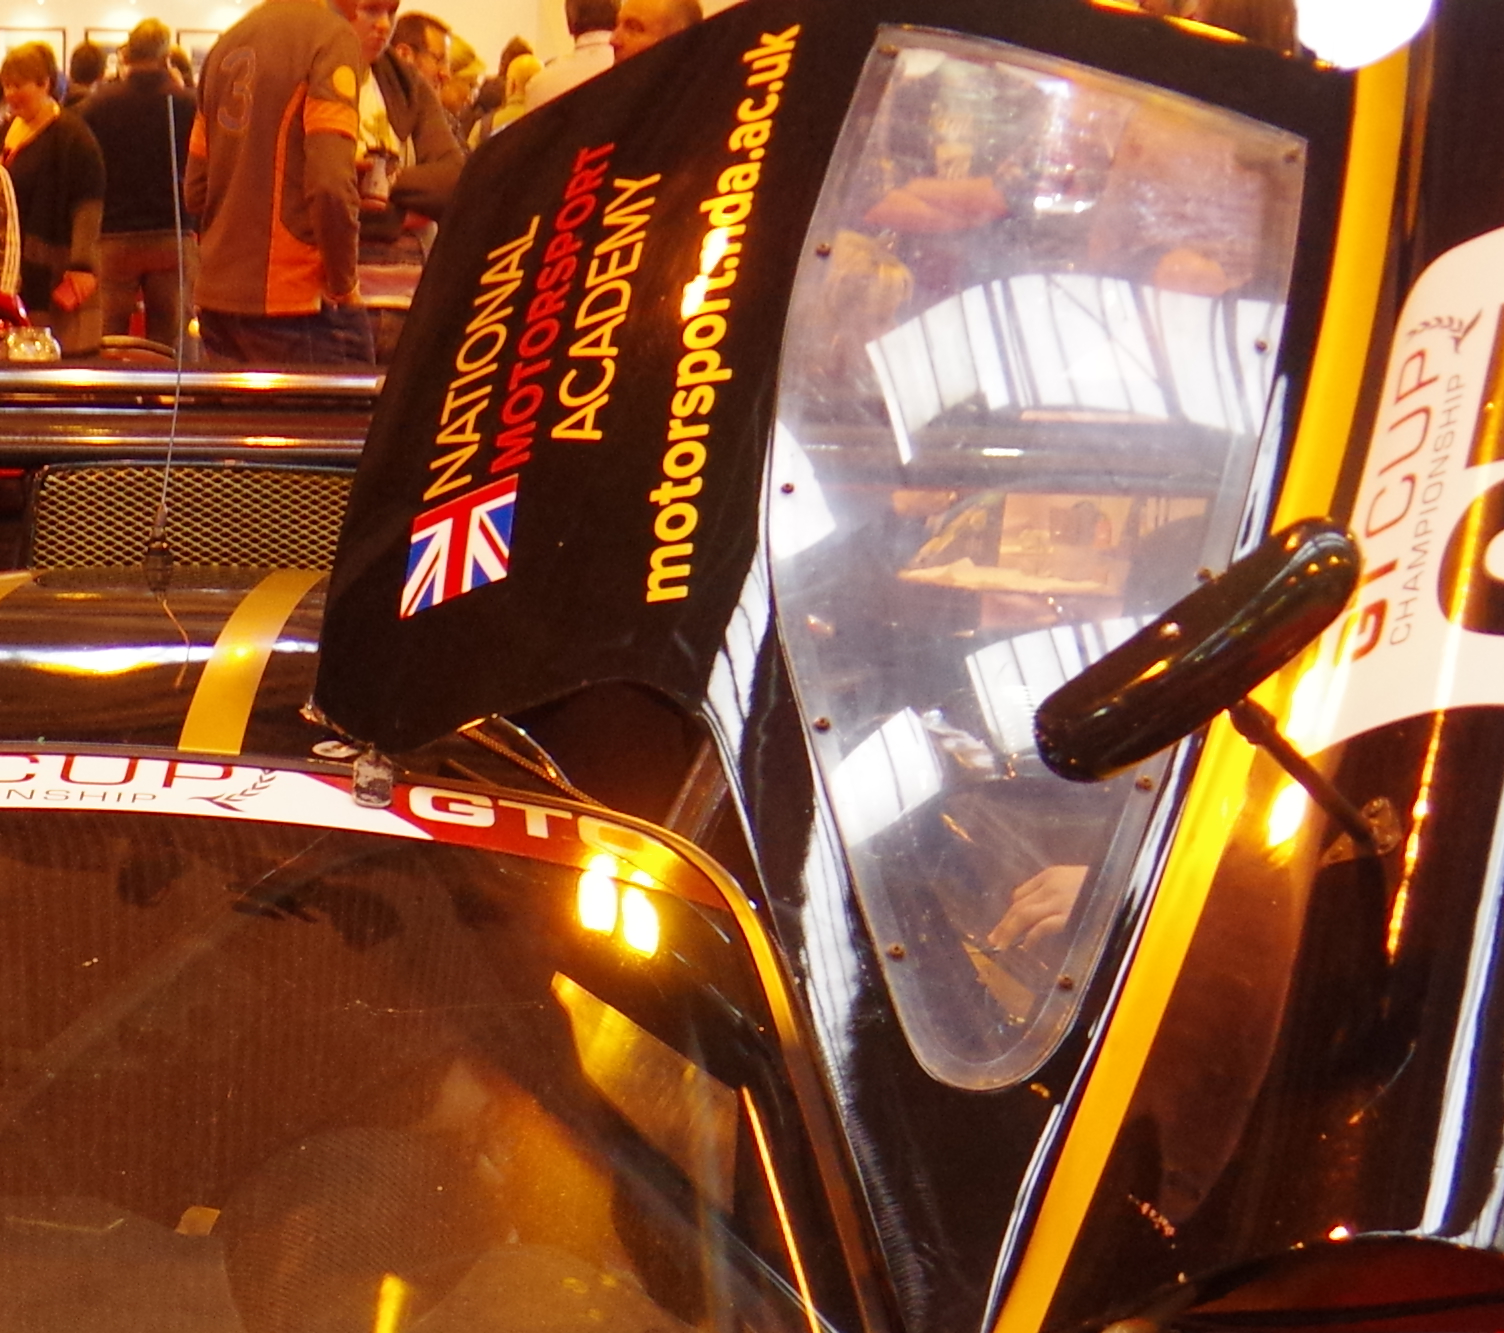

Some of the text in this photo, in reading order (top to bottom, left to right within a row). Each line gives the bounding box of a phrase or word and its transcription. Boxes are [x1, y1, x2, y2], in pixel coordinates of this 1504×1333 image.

[423, 215, 540, 501] NATIONAL
[491, 142, 615, 474] MOTORSPORT
[551, 173, 661, 442] ACADEMY
[646, 24, 801, 604] motorsport.nda.ac.uk
[1365, 349, 1440, 539] CUP
[1389, 373, 1466, 647] CHAMPIONSHIP
